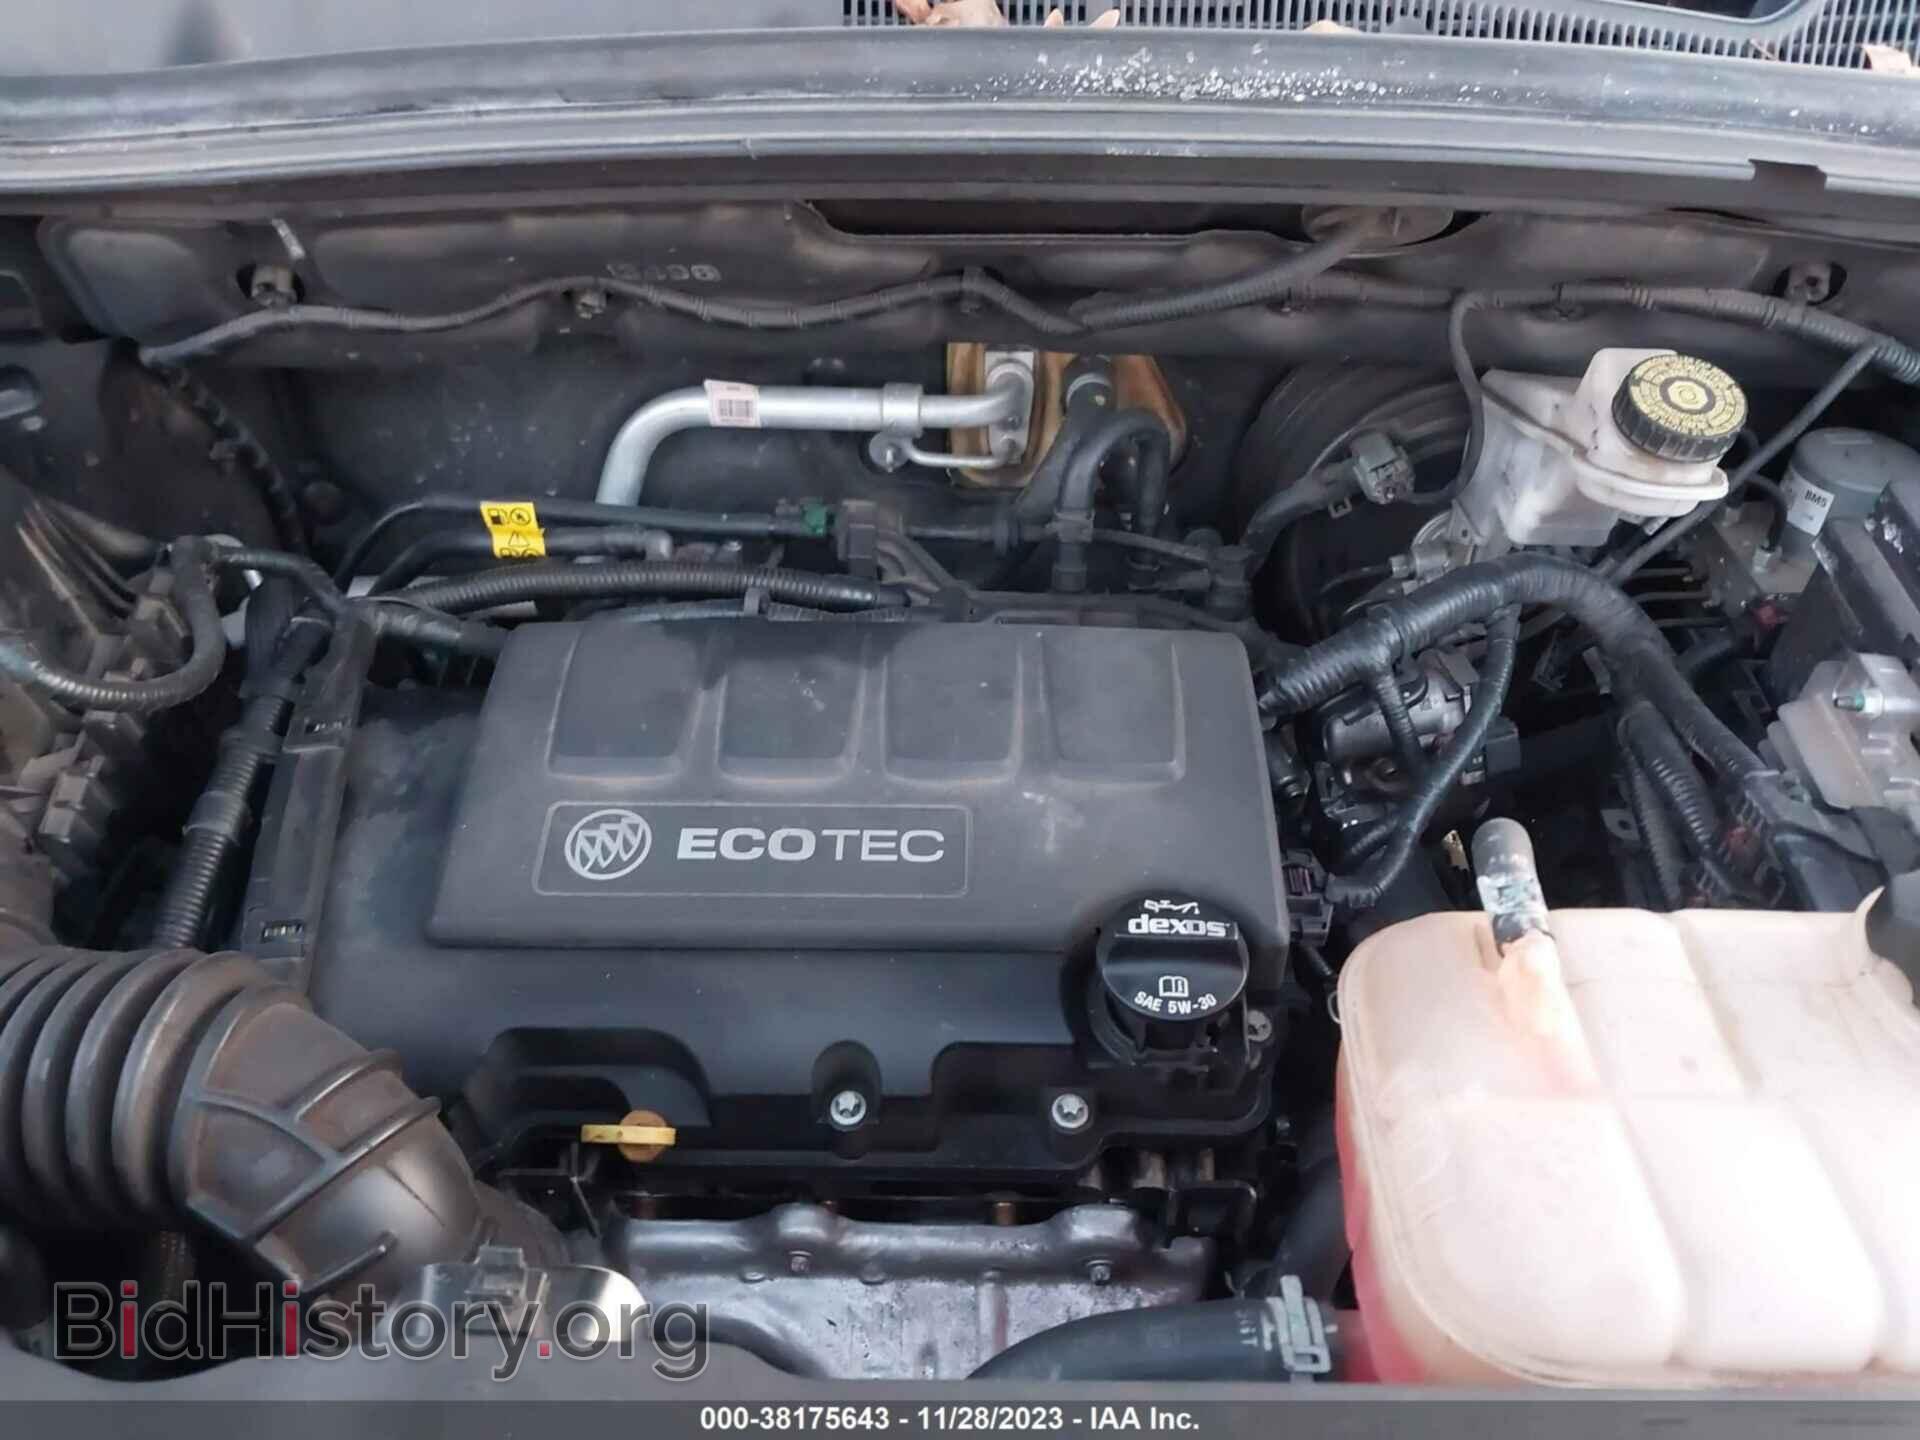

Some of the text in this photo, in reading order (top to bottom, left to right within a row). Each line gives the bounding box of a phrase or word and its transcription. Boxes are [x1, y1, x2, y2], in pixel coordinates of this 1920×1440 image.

[677, 827, 945, 863] ECOTEC
[1128, 913, 1227, 938] dexos
[1134, 991, 1218, 1015] SAE 5W-30
